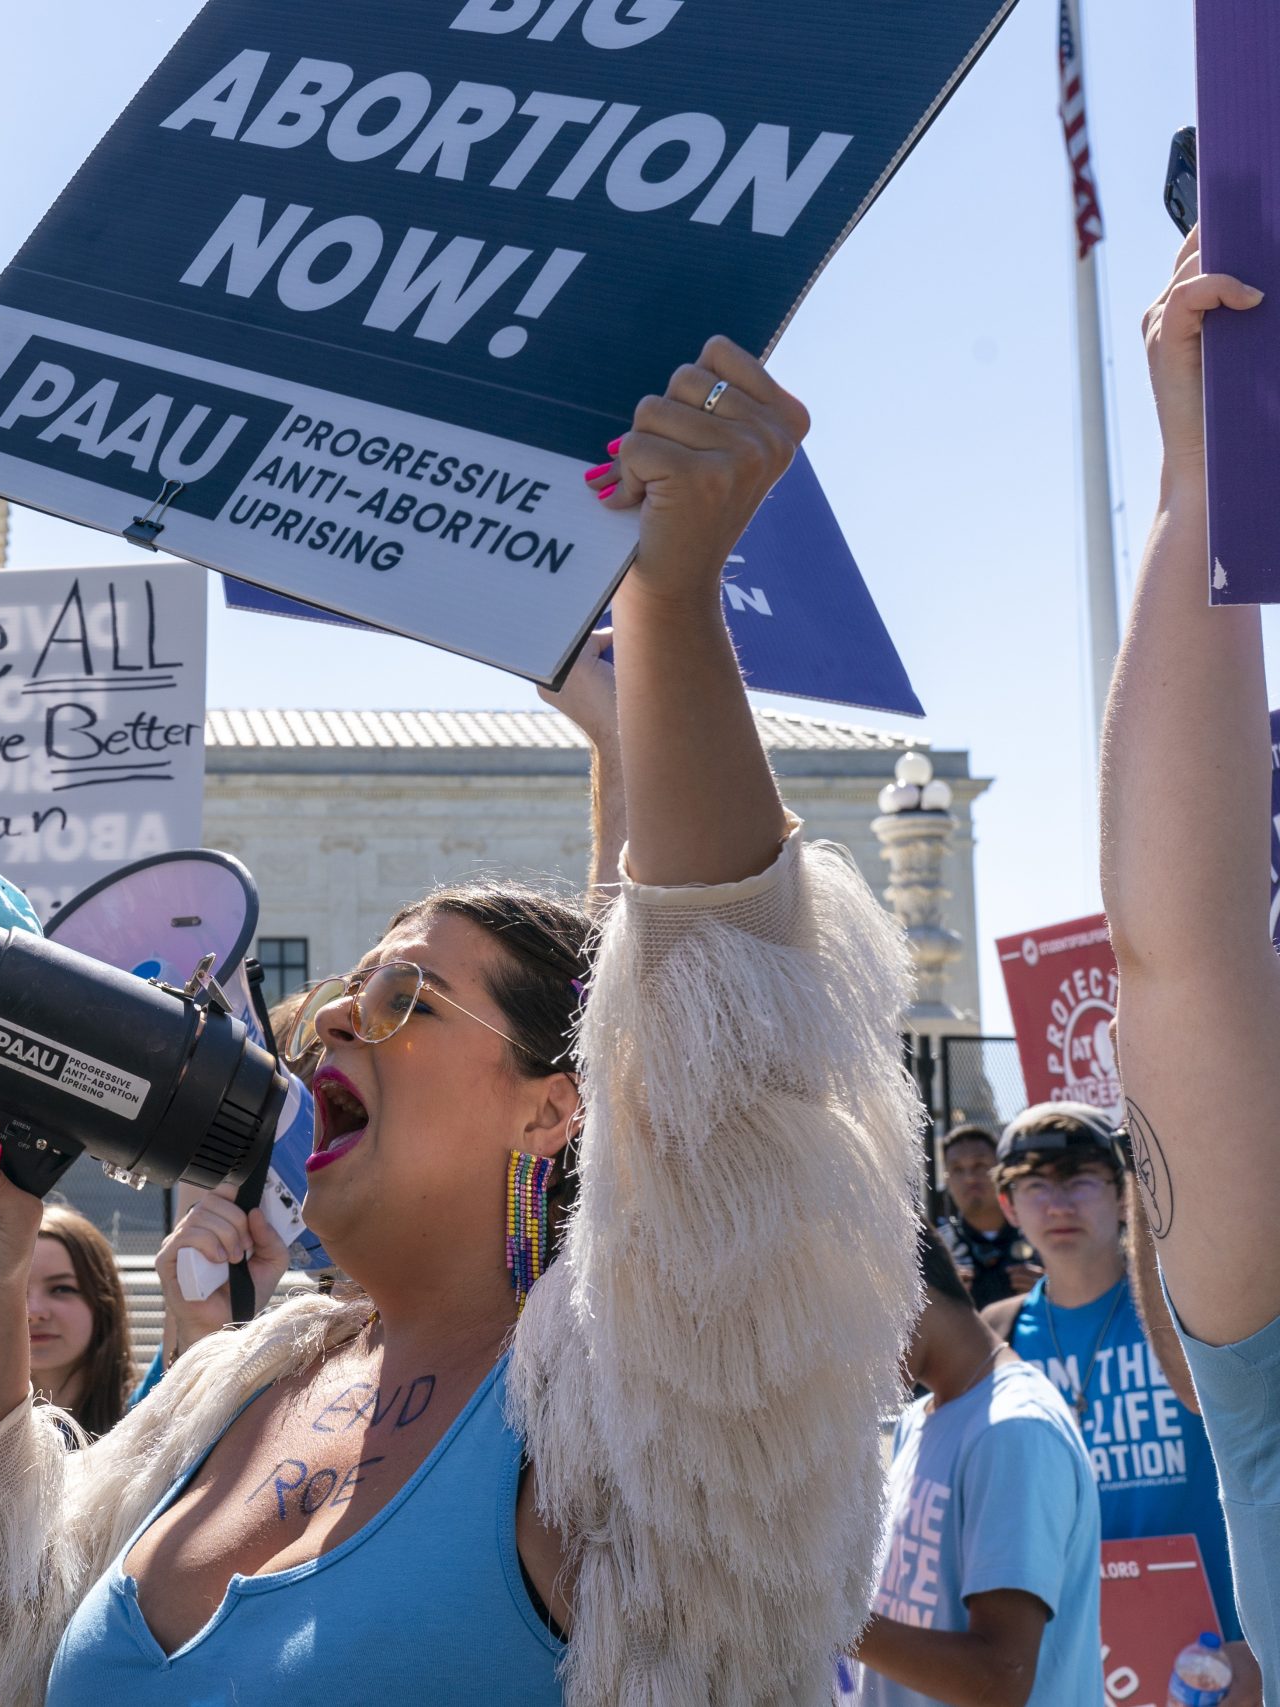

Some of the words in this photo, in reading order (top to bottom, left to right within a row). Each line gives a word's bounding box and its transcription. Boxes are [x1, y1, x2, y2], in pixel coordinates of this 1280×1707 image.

[159, 48, 854, 238] ABORTION
[178, 194, 587, 359] NOW!
[281, 413, 551, 514] PROGRESSIVE
[228, 494, 405, 571] UPRISING
[253, 455, 575, 574] ANTI-ABORTION
[30, 578, 184, 679] ALL
[45, 701, 203, 762] Better
[1046, 967, 1118, 1074] PROTECT
[1071, 1034, 1091, 1060] AT
[61, 1075, 105, 1099] UPRISING
[64, 1066, 140, 1104] ANTI-ABORTION
[68, 1056, 132, 1090] PROGRESSIVE
[1051, 1081, 1121, 1108] CONCEP
[11, 1119, 31, 1131] SIREN
[1095, 1341, 1171, 1395] THE
[311, 1373, 437, 1434] END
[1074, 1388, 1182, 1444] -LIFE
[1090, 1438, 1187, 1483] ATION
[904, 1476, 952, 1544] HE
[880, 1534, 942, 1606] IFE
[1099, 1560, 1141, 1579] .ORG
